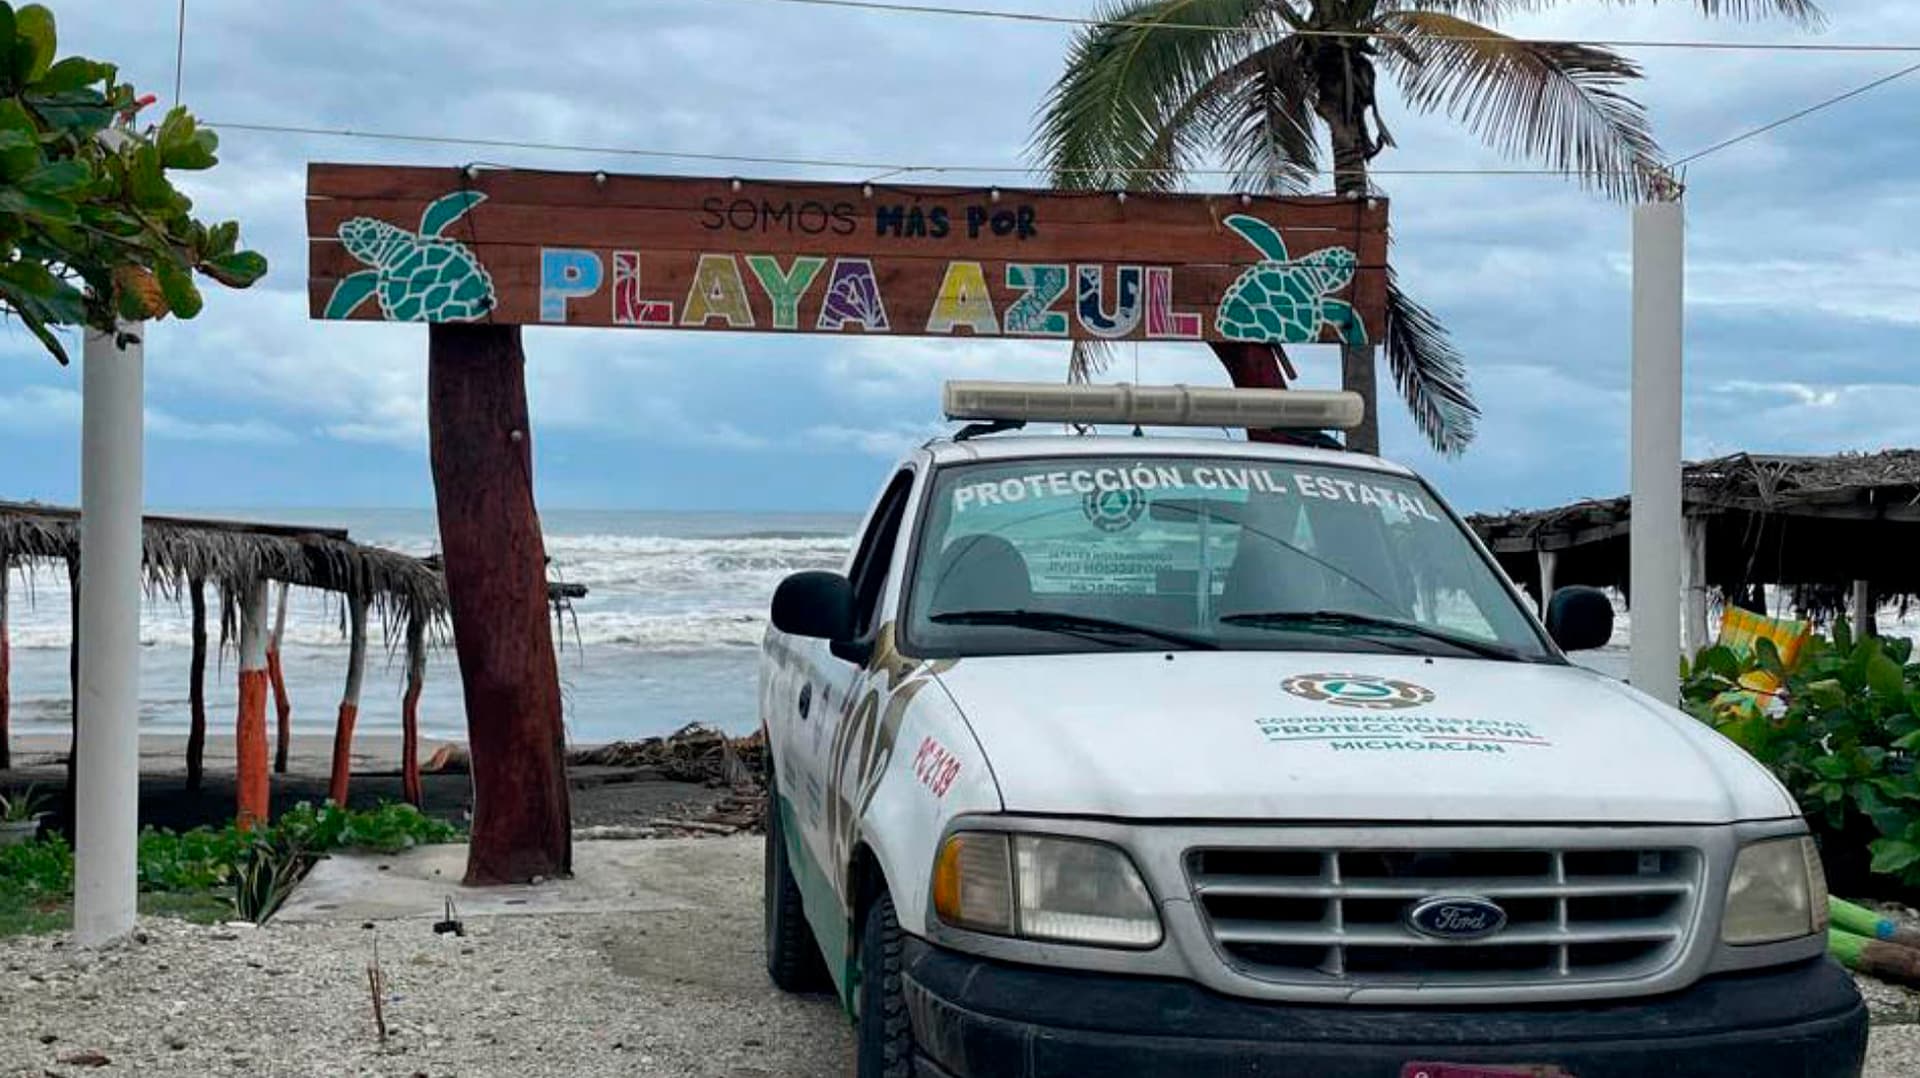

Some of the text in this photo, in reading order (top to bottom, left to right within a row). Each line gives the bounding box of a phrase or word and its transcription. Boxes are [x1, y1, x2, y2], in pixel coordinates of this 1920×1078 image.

[700, 198, 1037, 240] SOMOS MÁS POR
[539, 247, 1201, 339] PLAYA AZUL
[953, 462, 1440, 523] PROTECCIÓN CIVIL ESTATAL
[1435, 906, 1485, 929] Ford
